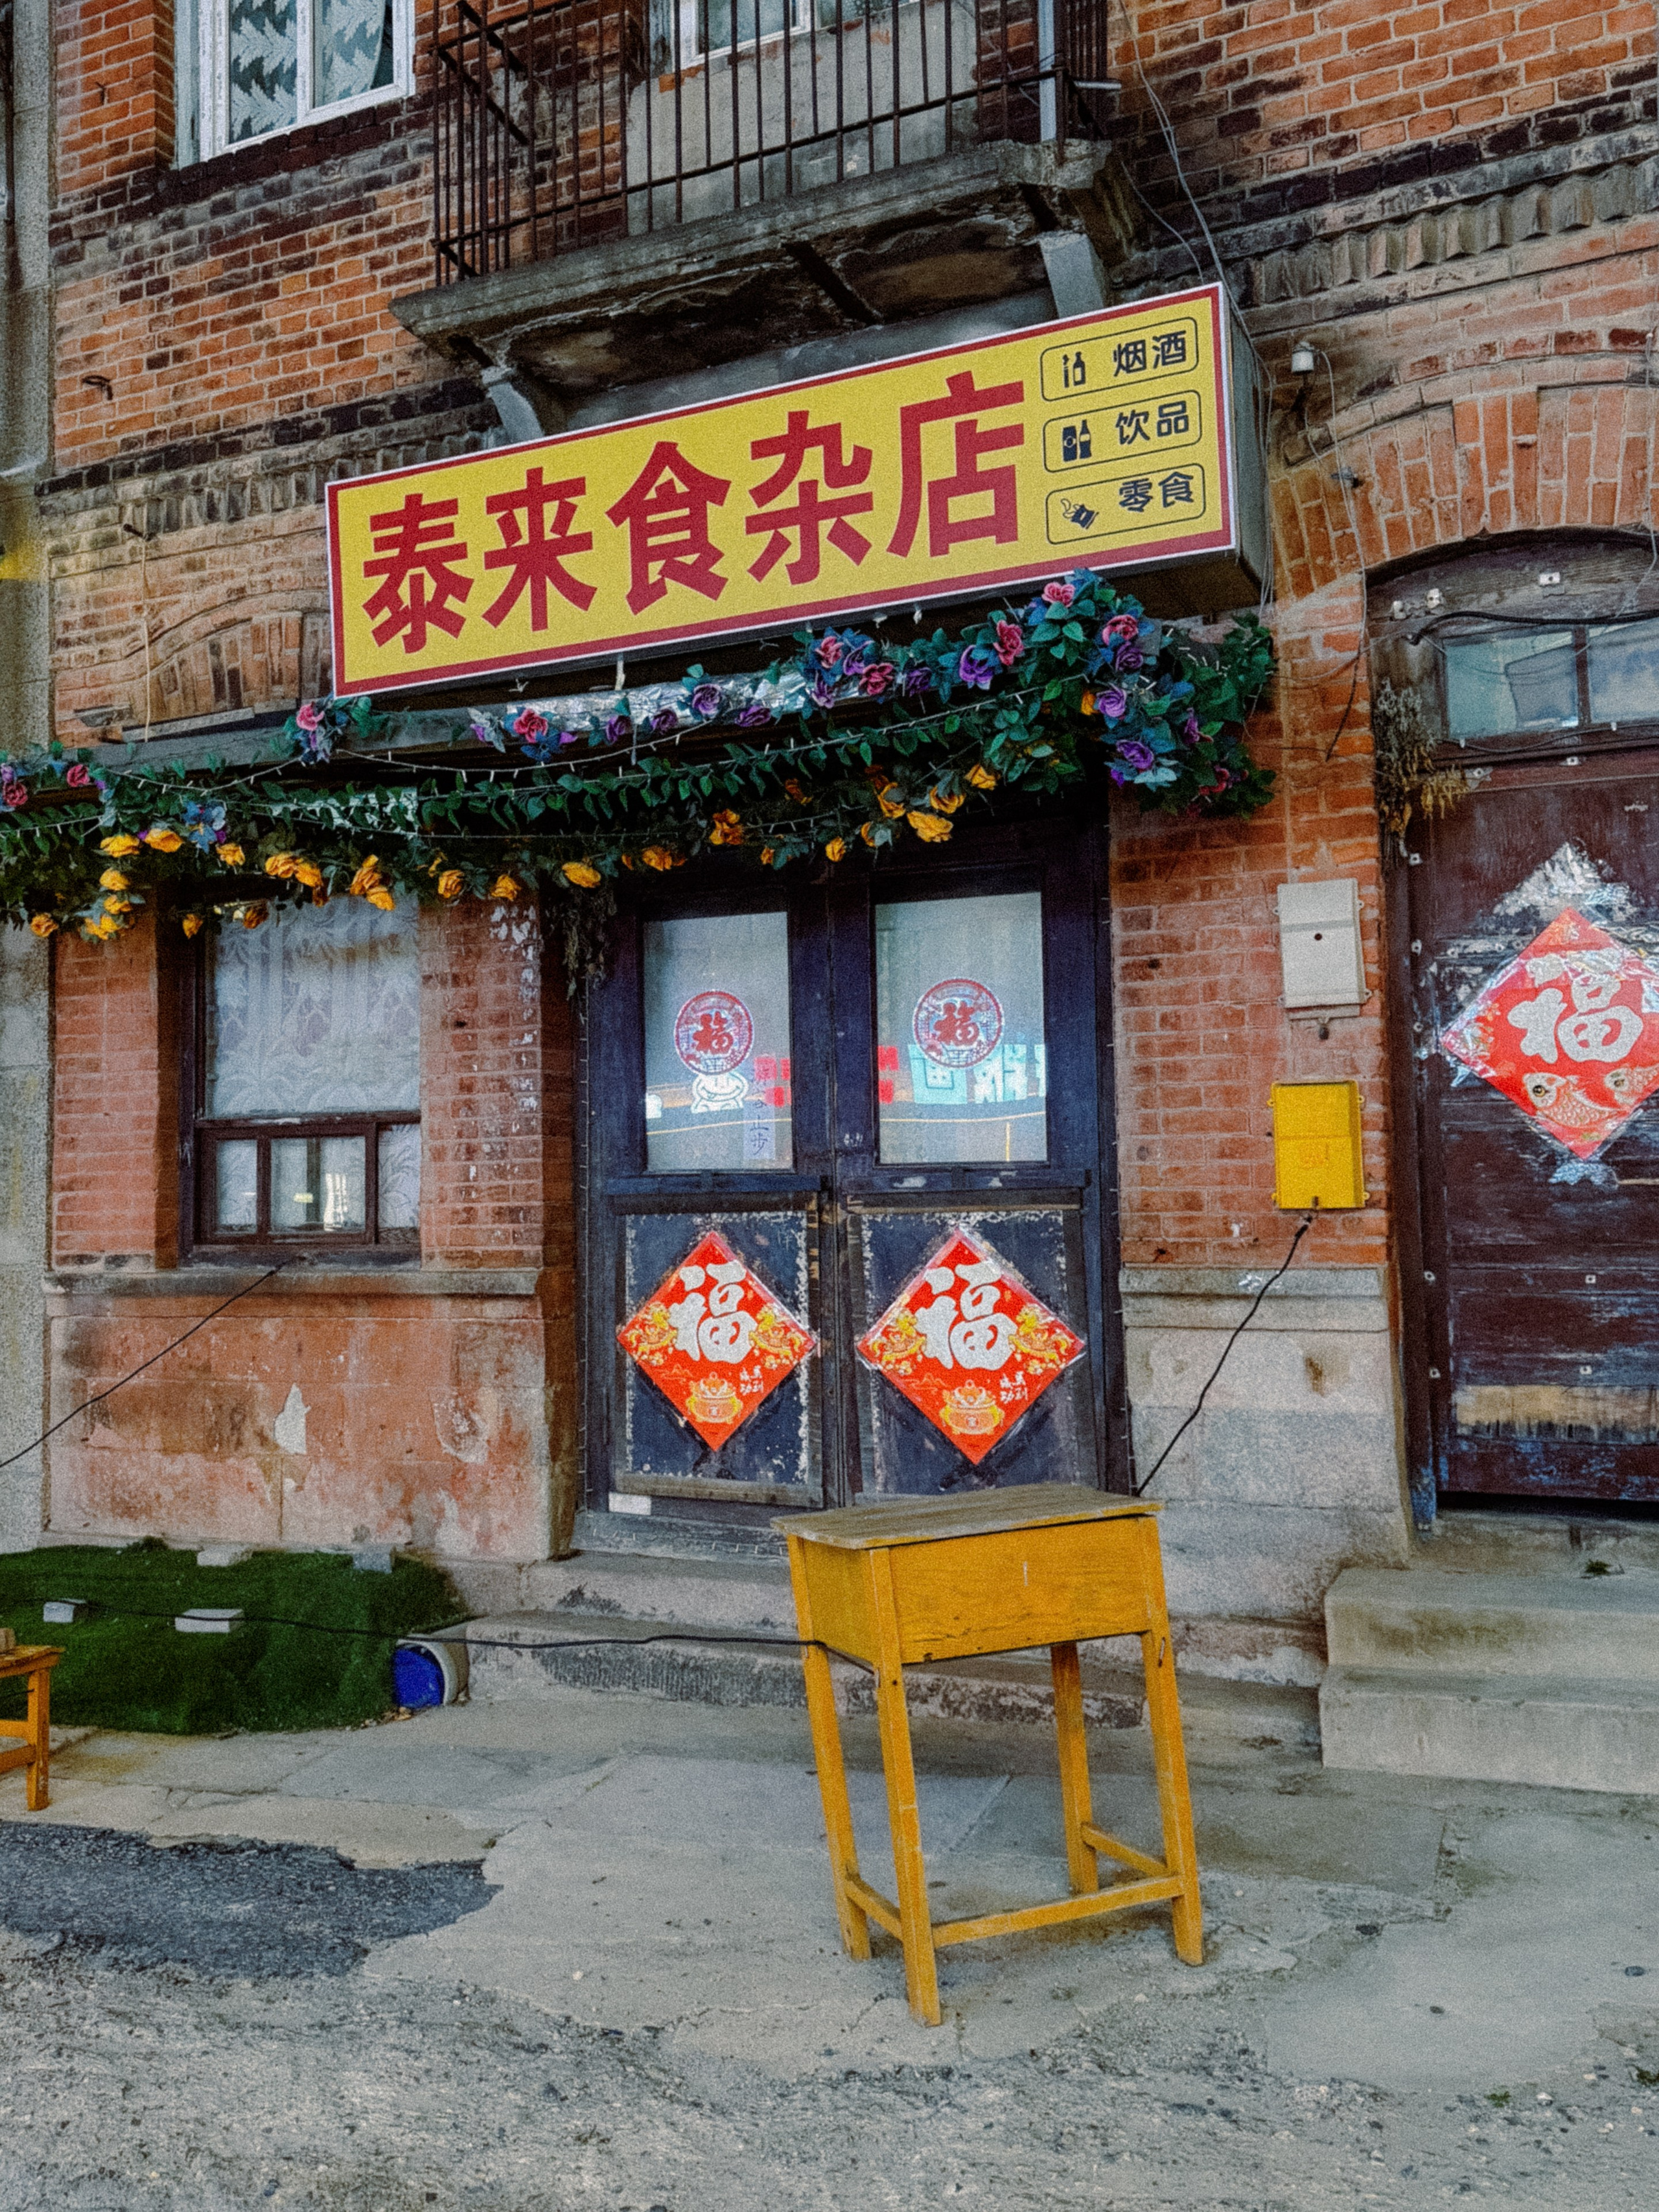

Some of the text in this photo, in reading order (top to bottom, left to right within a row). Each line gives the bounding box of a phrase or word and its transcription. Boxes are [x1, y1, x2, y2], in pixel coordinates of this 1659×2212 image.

[1113, 330, 1186, 377] 烟酒
[1115, 400, 1190, 445] 饮品
[362, 371, 1025, 654] 泰来食杂店
[1119, 471, 1194, 513] 零食
[1507, 947, 1643, 1064] 福
[667, 1260, 758, 1364] 福
[914, 1261, 1018, 1371] 福
